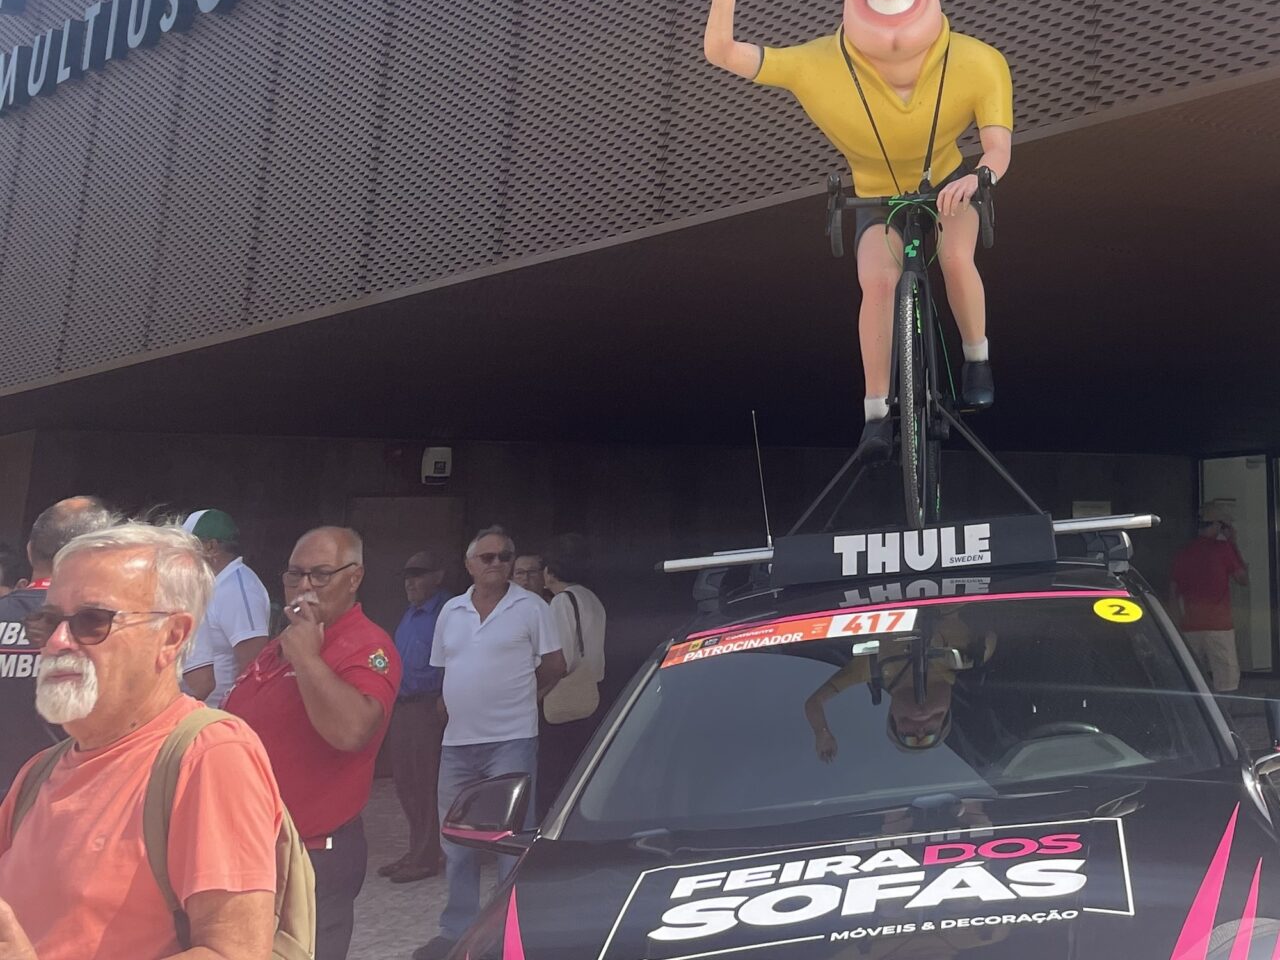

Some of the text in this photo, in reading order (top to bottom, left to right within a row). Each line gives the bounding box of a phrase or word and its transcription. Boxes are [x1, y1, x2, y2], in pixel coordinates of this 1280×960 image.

[834, 523, 991, 576] THULE
[950, 554, 984, 564] SWEDEN
[841, 612, 906, 635] 417
[1107, 604, 1130, 616] 2
[683, 632, 804, 662] PATROCINADOR
[647, 858, 1088, 941] SOFÁS
[829, 908, 1080, 942] MÓVEIS & DECORAÇÃO
